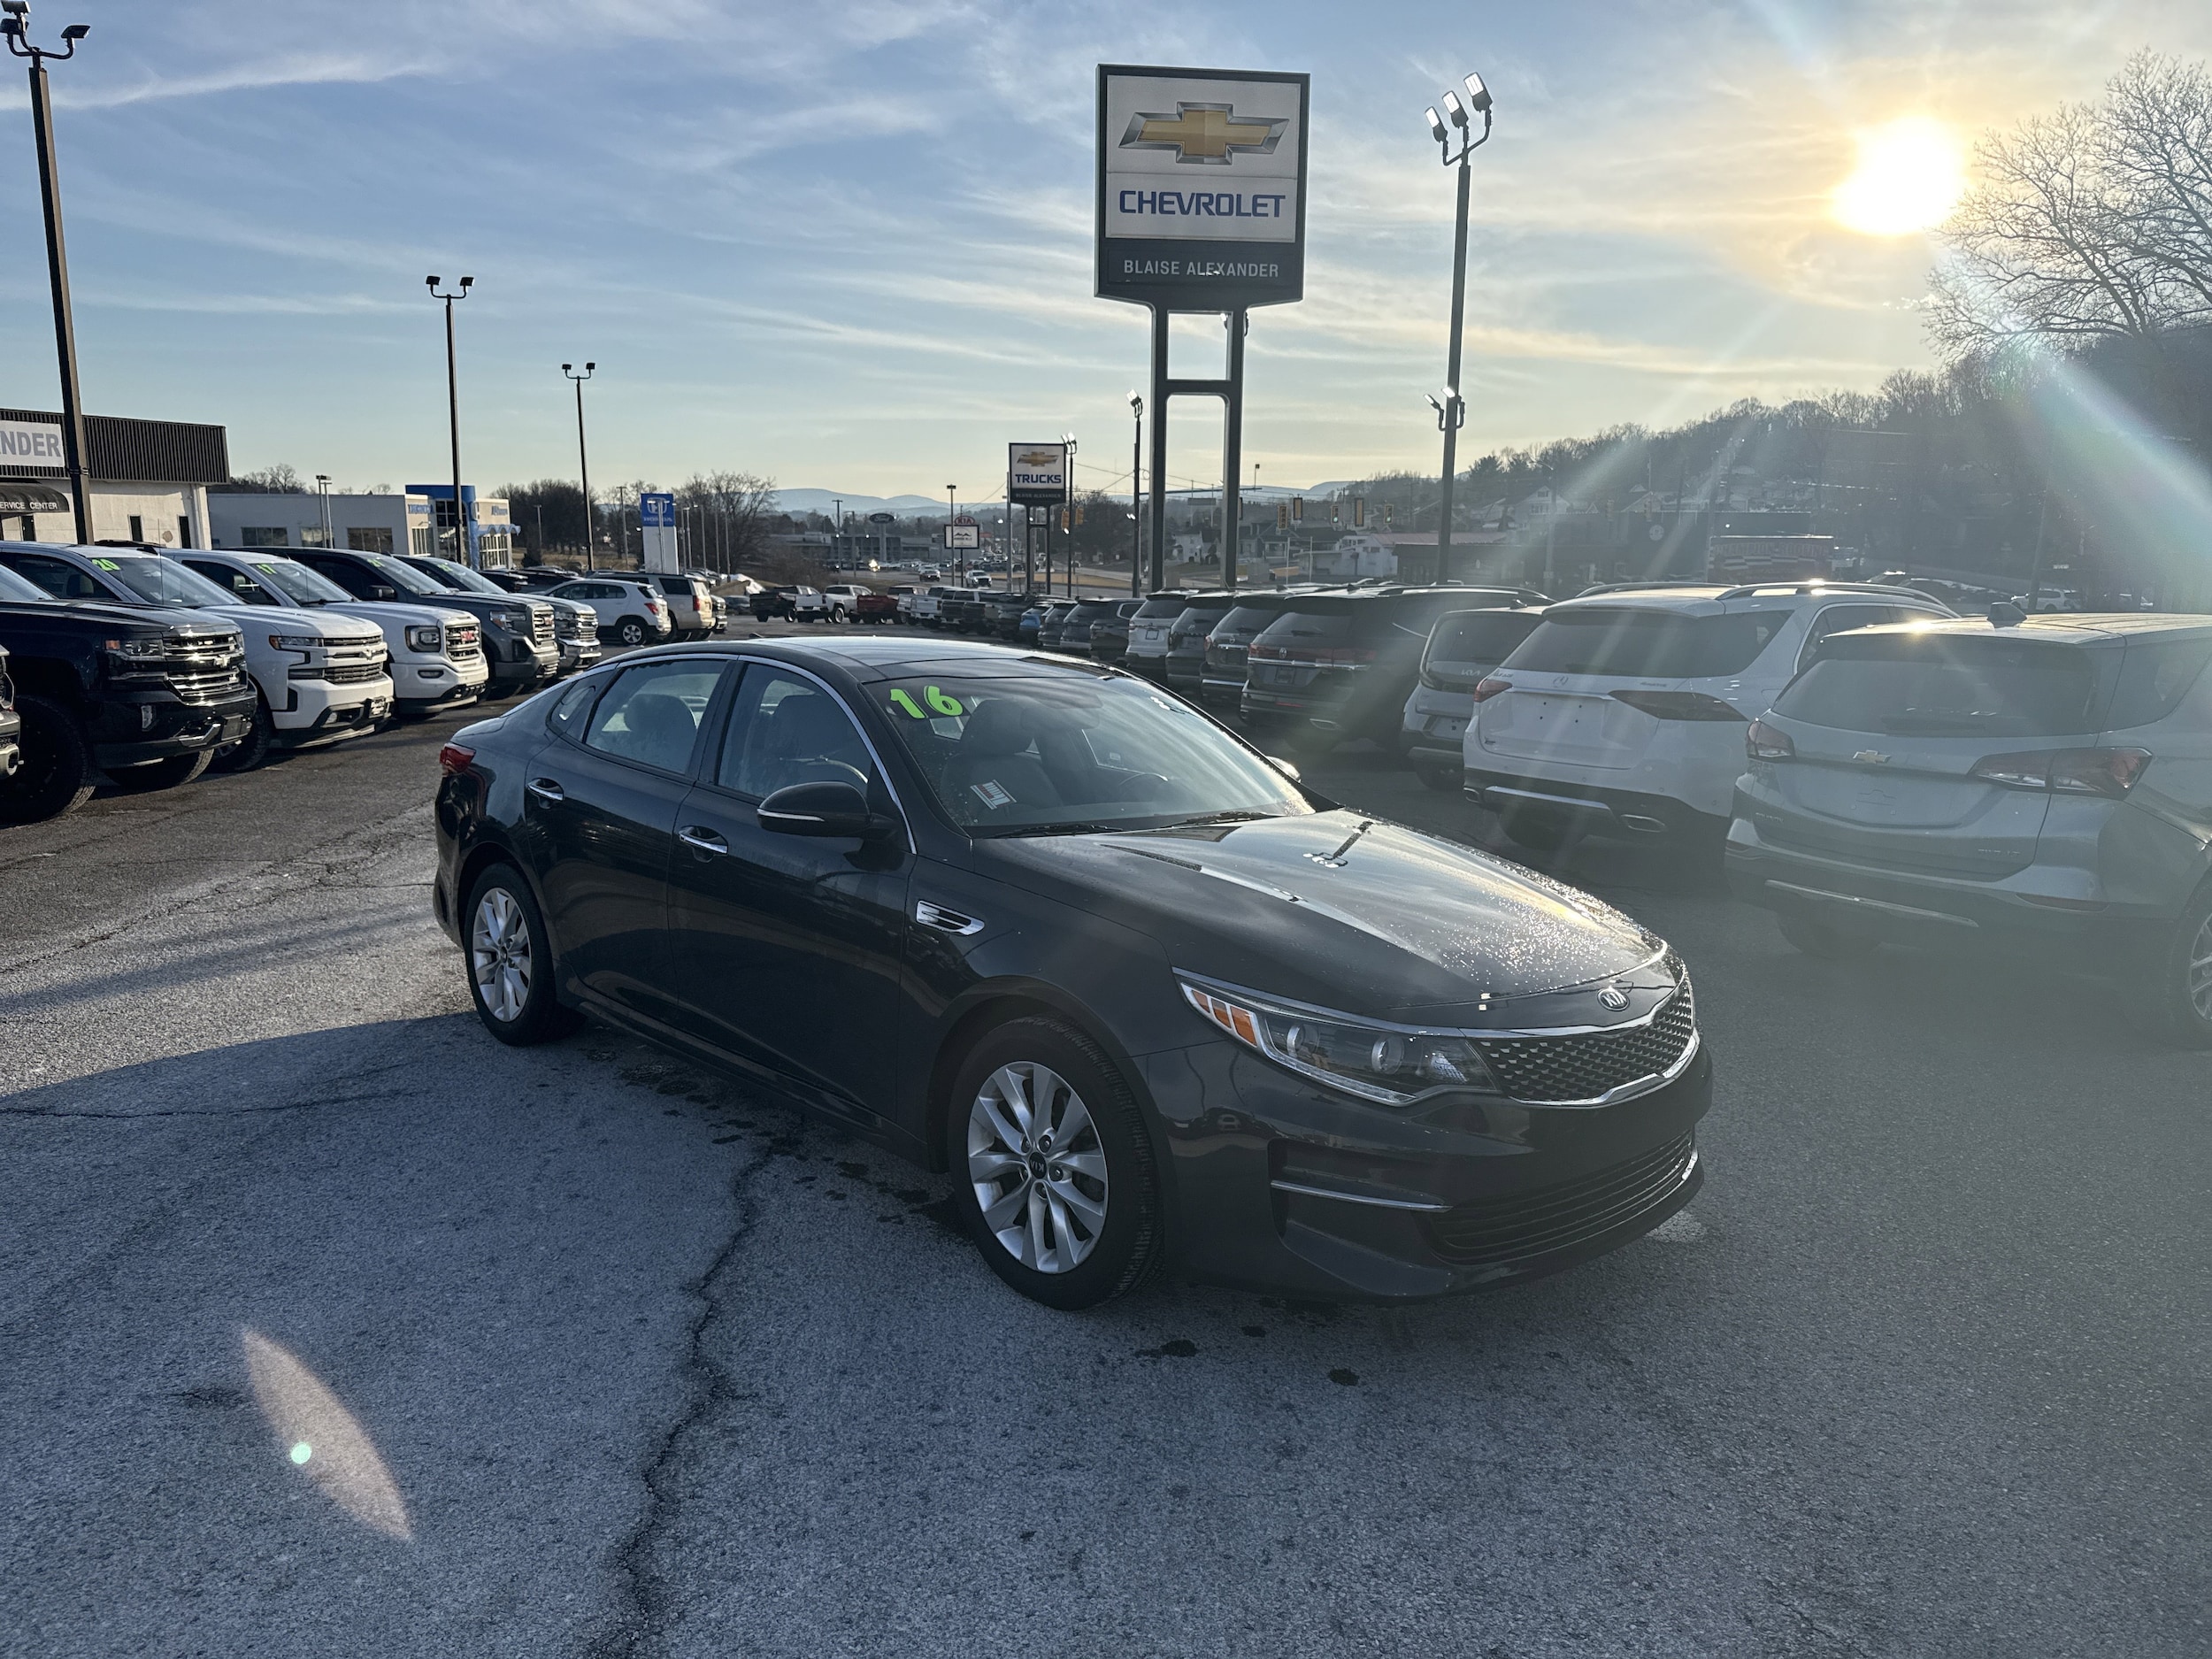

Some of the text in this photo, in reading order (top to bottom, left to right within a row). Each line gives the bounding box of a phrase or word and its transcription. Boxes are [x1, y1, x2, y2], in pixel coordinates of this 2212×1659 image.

[1119, 190, 1286, 218] CHEVROLET
[1124, 259, 1279, 277] BLAISE ALEXANDER
[0, 430, 62, 457] NDER
[1015, 473, 1062, 484] TRUCKS
[91, 558, 121, 572] 20
[256, 563, 278, 575] 17
[889, 685, 964, 719] 16
[1601, 991, 1628, 1007] KIA
